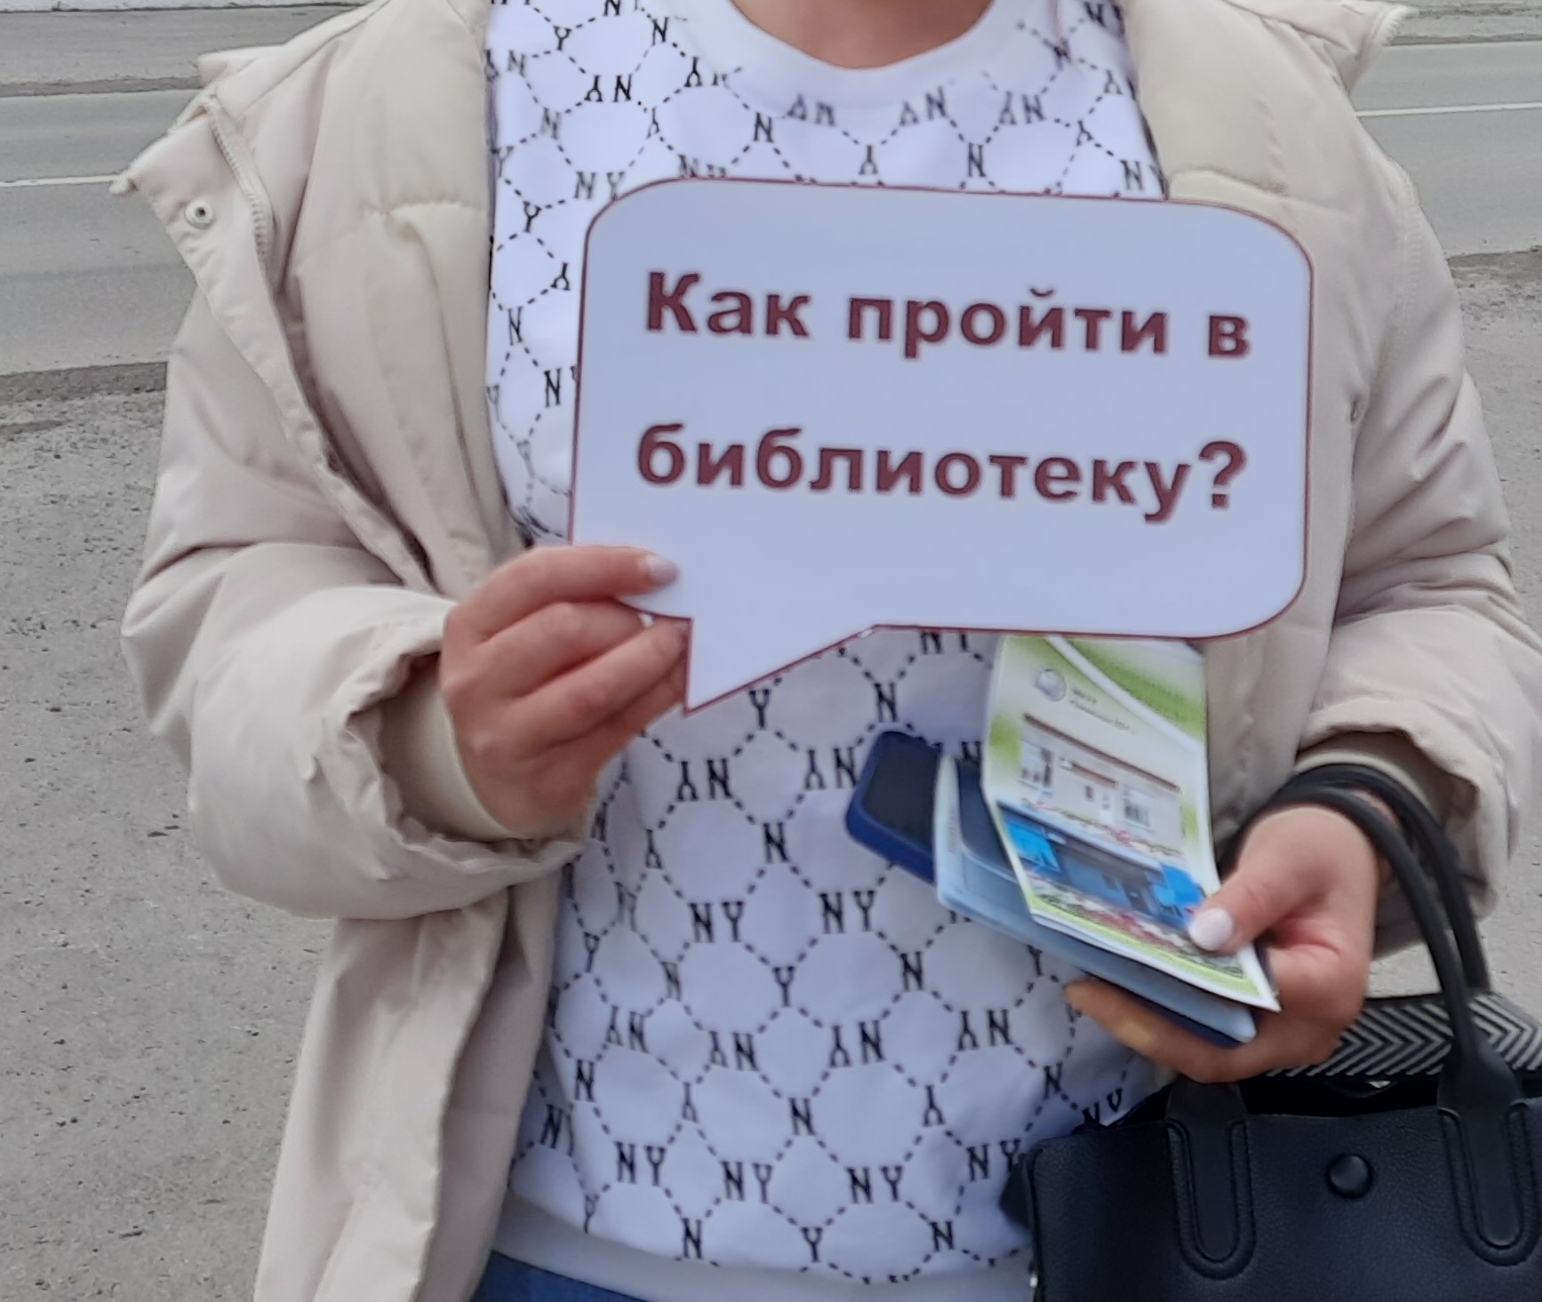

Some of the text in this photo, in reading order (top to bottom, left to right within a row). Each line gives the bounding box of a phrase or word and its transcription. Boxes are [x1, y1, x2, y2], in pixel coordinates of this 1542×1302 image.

[644, 269, 1251, 360] Как пройти в
[637, 423, 1248, 523] библиотеку?
[689, 900, 745, 943] NY
[820, 889, 875, 934] NY
[614, 1141, 666, 1187] NY
[721, 1161, 774, 1204] NY
[846, 1165, 904, 1204] NY
